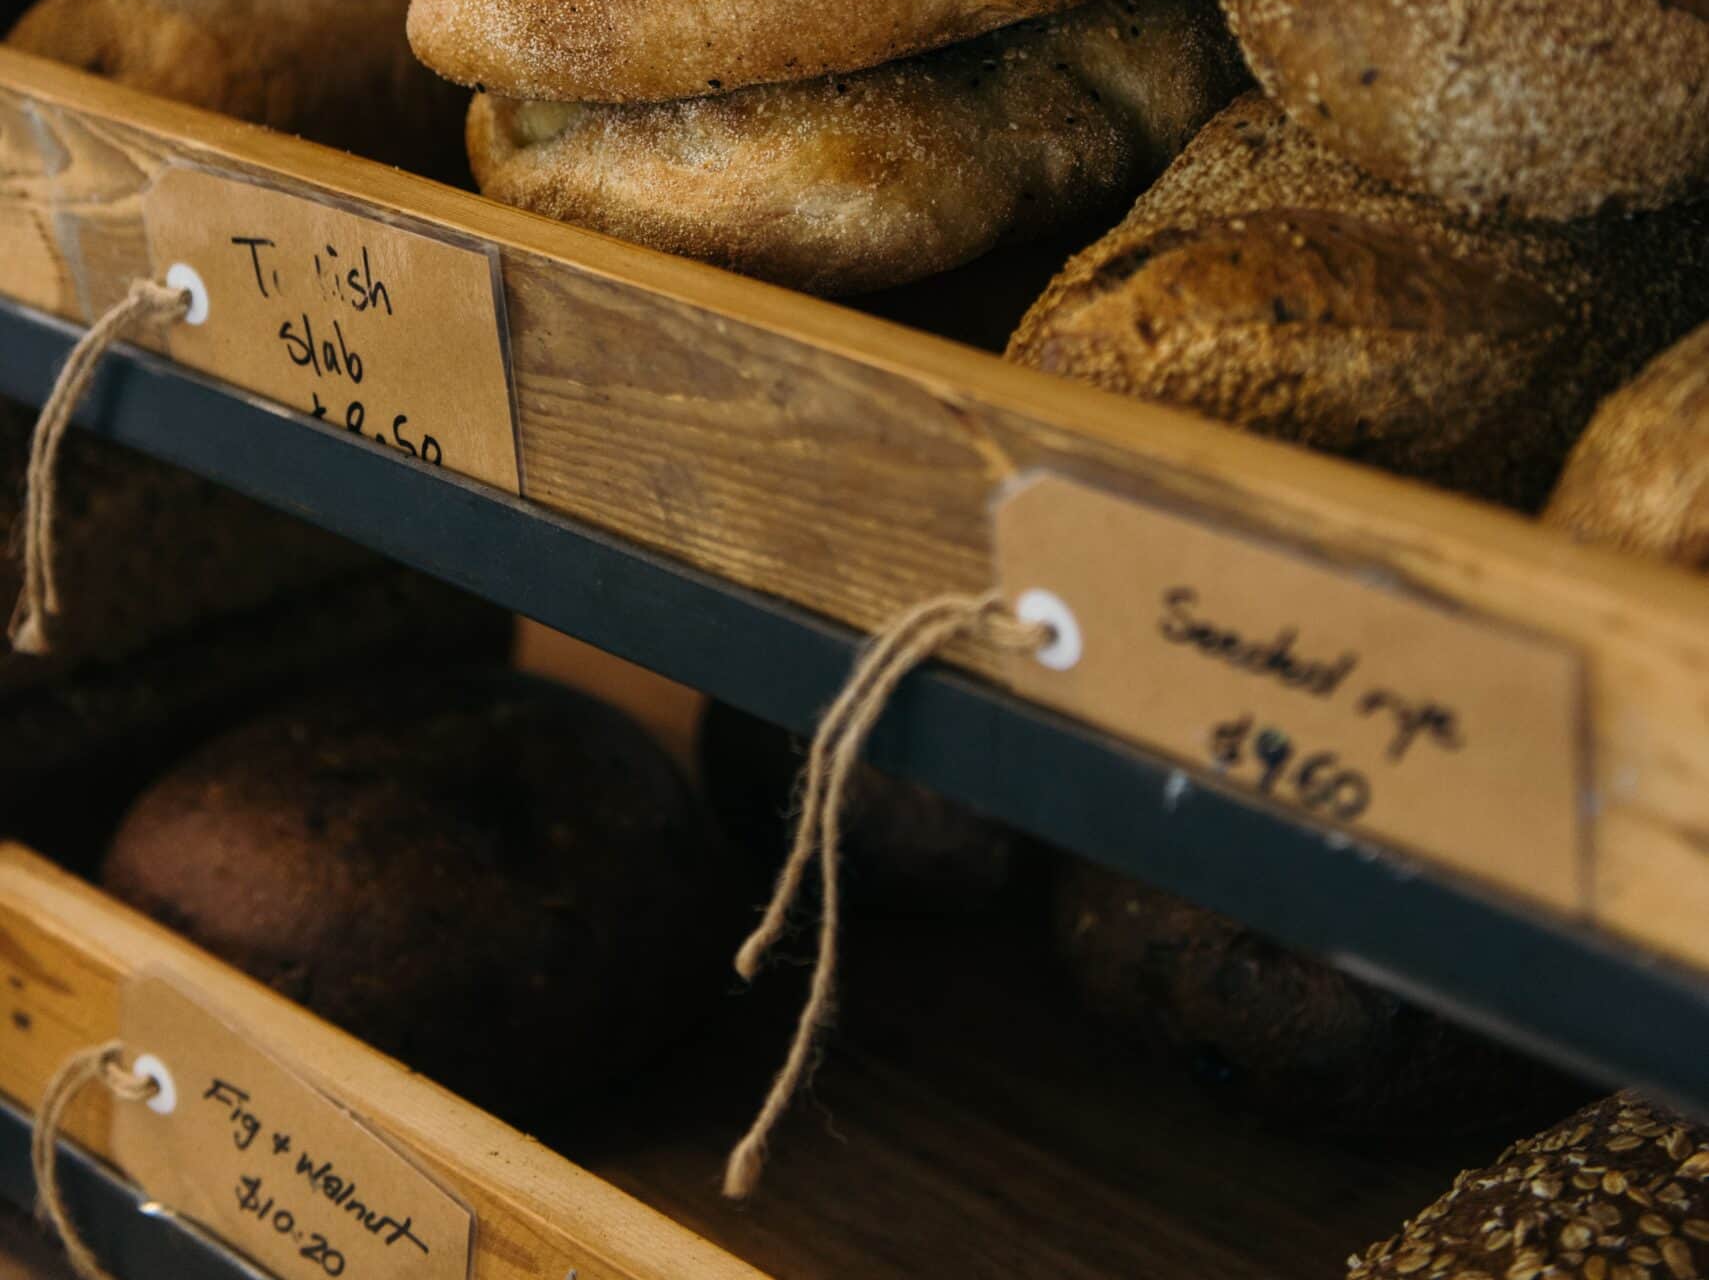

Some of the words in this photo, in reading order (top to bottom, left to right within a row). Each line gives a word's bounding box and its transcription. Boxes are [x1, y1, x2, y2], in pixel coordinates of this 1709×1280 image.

[231, 236, 393, 316] Tish
[203, 1078, 261, 1151] Fig
[235, 1174, 346, 1277] $10.20
